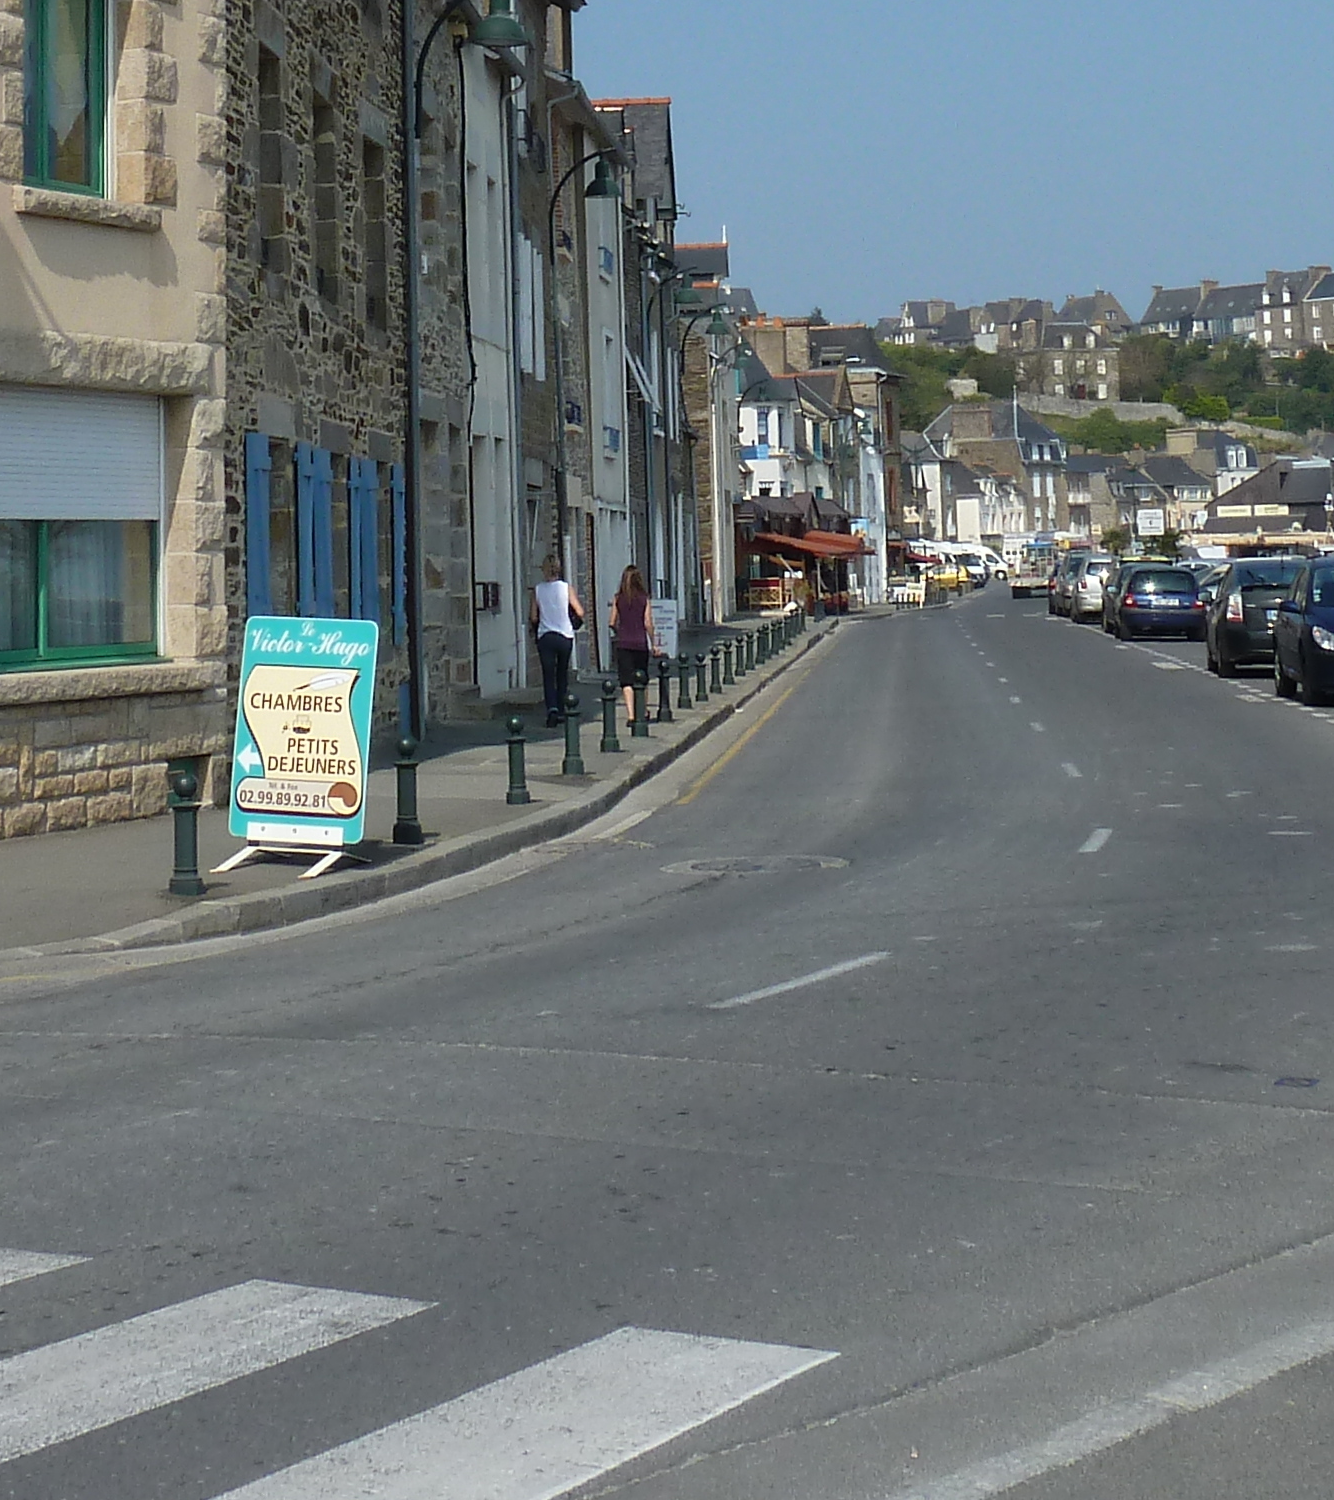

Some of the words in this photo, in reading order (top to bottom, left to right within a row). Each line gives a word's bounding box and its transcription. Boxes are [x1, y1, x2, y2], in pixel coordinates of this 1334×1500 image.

[300, 620, 316, 636] Le
[250, 692, 343, 713] CHAMBRES
[286, 737, 339, 756] PETITS
[267, 755, 357, 776] DEJEUNERS
[239, 789, 327, 808] 02.99.89.92.81
